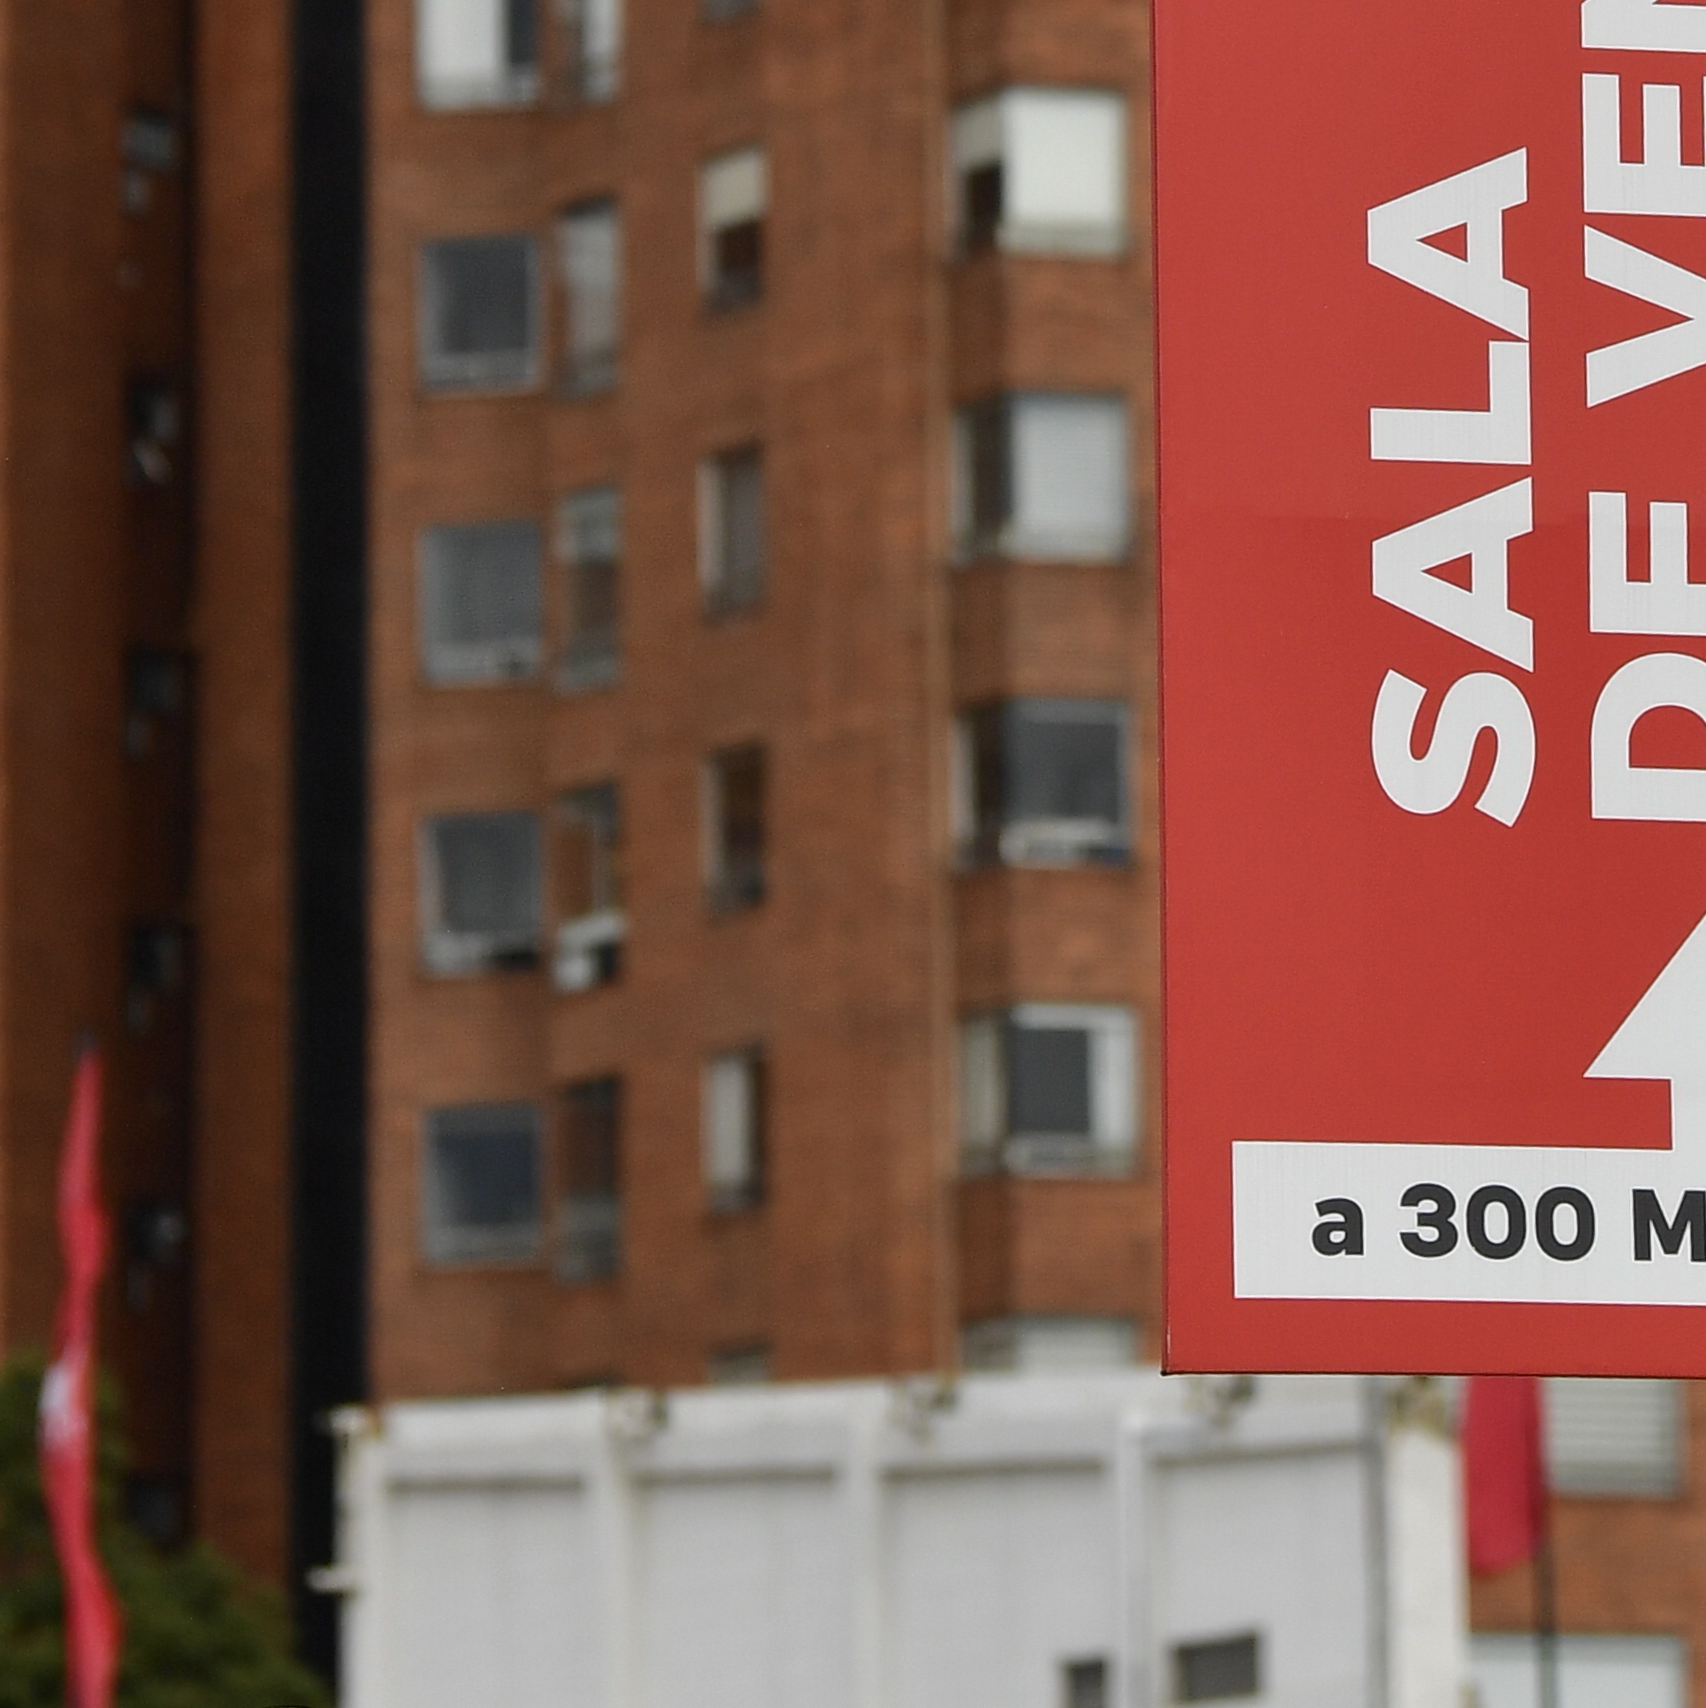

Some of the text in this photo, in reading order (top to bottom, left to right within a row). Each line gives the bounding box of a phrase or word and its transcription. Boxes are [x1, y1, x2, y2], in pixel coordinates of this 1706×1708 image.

[1367, 146, 1536, 828] SALA
[1311, 1196, 1365, 1258] a
[1399, 1182, 1597, 1262] 300
